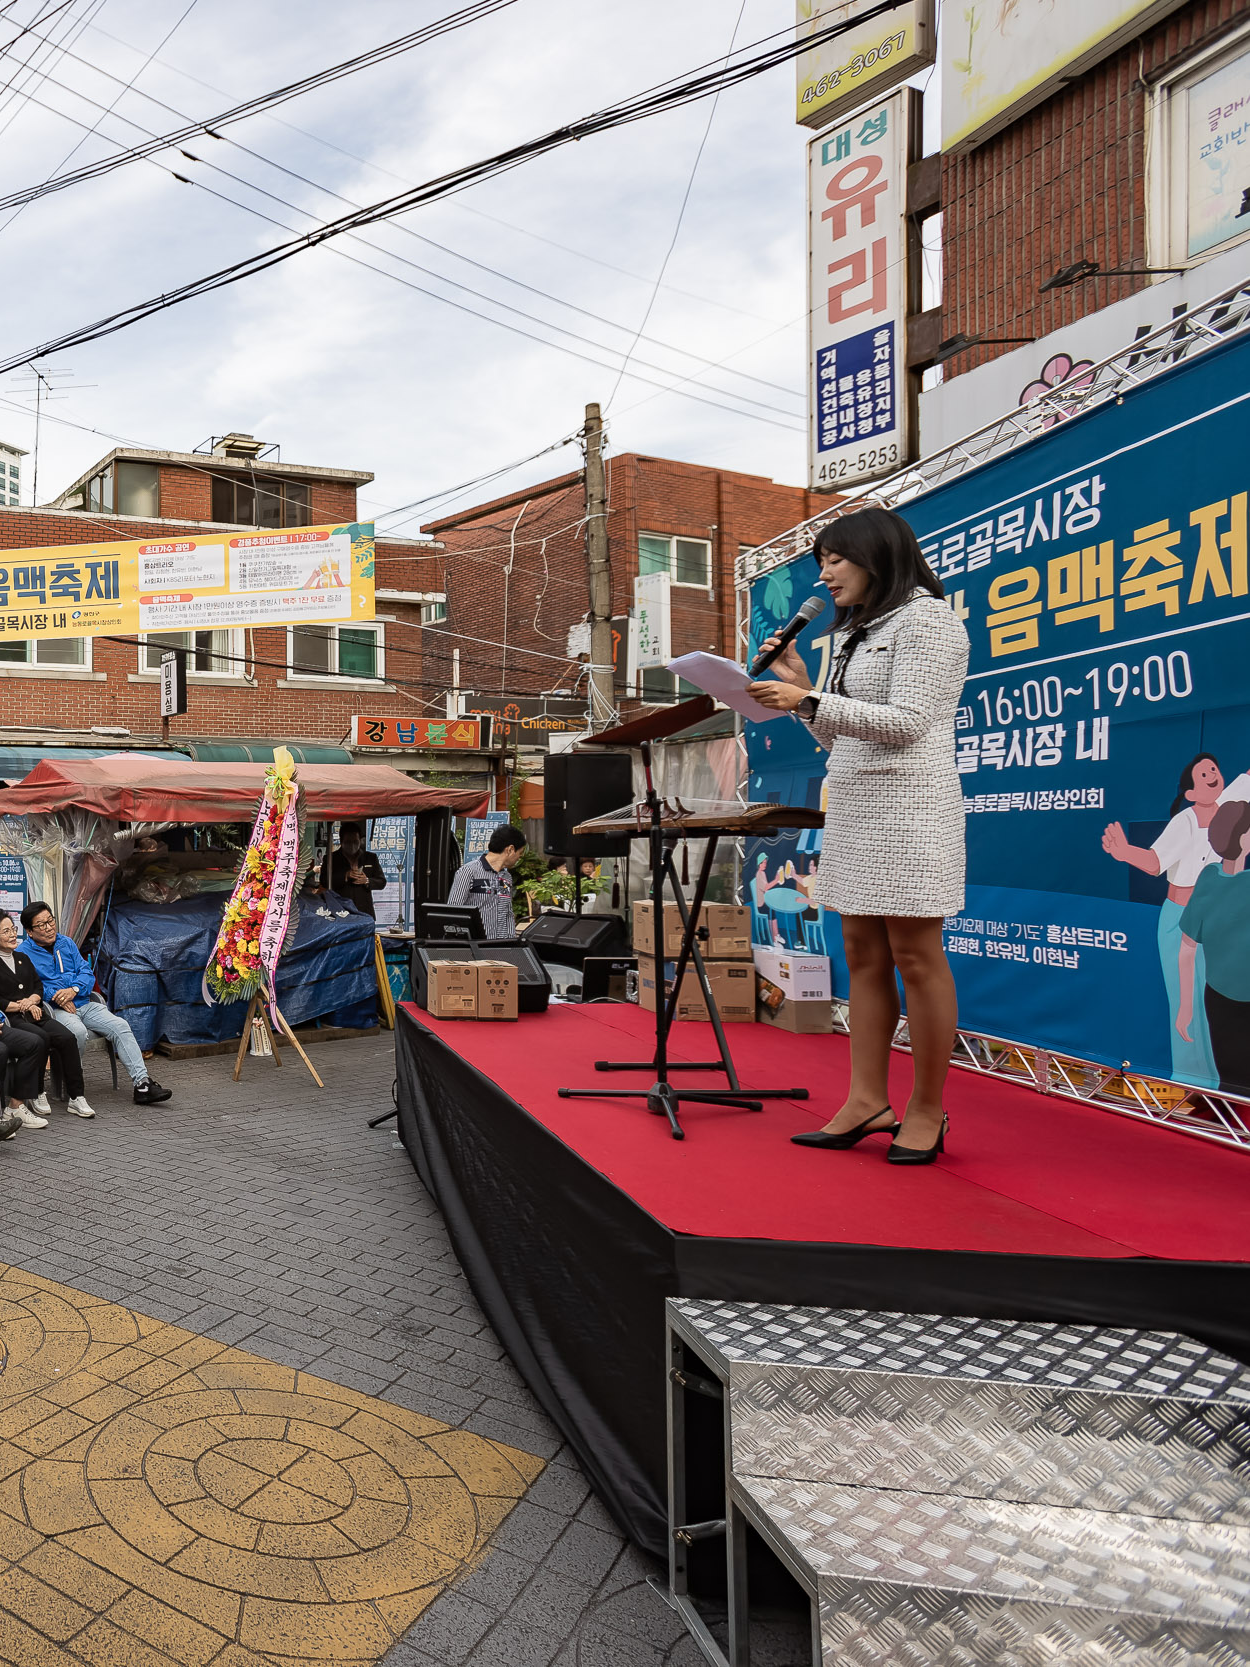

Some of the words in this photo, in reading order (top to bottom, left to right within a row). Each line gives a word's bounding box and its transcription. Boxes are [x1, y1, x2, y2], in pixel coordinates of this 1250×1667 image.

[801, 30, 907, 105] 462-3067
[821, 108, 887, 166] 대성
[821, 154, 888, 325] 유리
[818, 443, 899, 482] 462-5253
[175, 543, 190, 552] 공연
[986, 490, 1249, 658] 음맥축제
[52, 613, 67, 630] 내
[639, 610, 650, 654] 풍성한
[652, 635, 660, 656] 교회
[977, 650, 1194, 728] 16:00~19:00
[364, 719, 476, 747] 강남분식
[521, 716, 566, 730] Chicken
[1075, 716, 1110, 761] 내
[985, 940, 1030, 964] 한유빈,
[1032, 946, 1080, 969] 이현남
[986, 921, 1008, 938] 대상
[1046, 924, 1129, 952] 홍삼트리오
